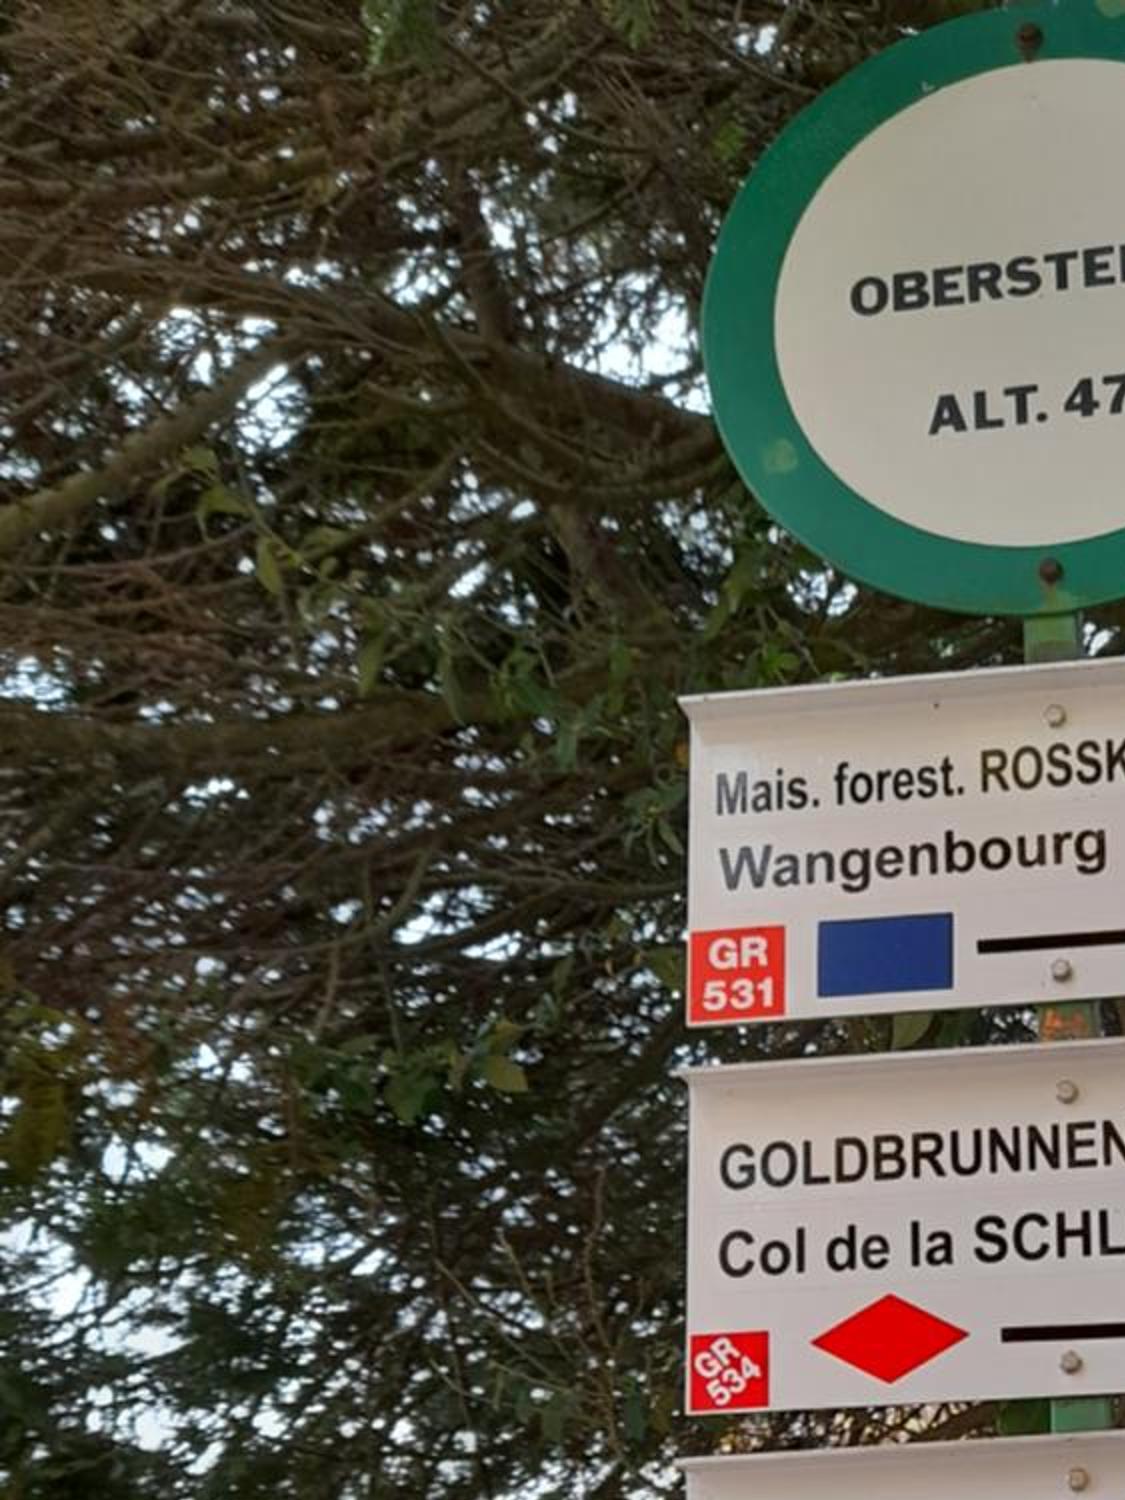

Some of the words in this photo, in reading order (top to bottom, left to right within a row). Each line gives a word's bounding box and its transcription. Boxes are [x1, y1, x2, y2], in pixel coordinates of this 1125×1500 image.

[928, 383, 1049, 436] ALT.
[716, 768, 821, 816] Mais.
[833, 756, 965, 806] forest.
[719, 828, 1107, 894] Wangenbourg
[709, 936, 767, 970] GR
[703, 976, 773, 1011] 531
[718, 1226, 806, 1279] Col
[826, 1223, 890, 1273] de
[910, 1220, 954, 1268] la
[695, 1337, 741, 1379] GR
[706, 1355, 762, 1406] 534
